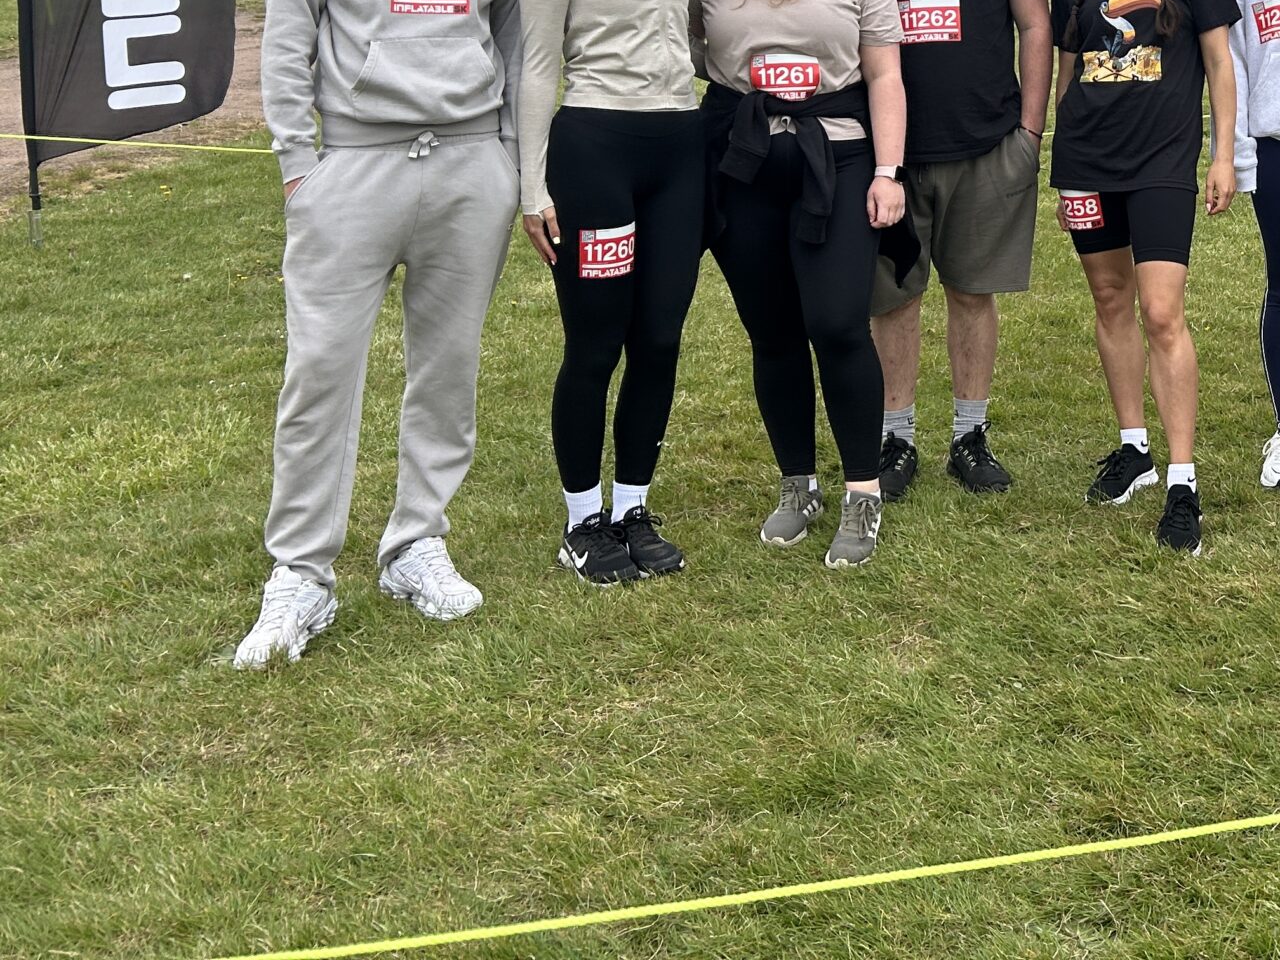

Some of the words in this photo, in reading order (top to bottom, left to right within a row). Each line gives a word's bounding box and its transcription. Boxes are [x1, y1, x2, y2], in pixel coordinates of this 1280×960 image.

[901, 9, 957, 29] 11262
[757, 66, 814, 85] 11261
[1064, 198, 1098, 217] 258
[583, 235, 635, 262] 11260
